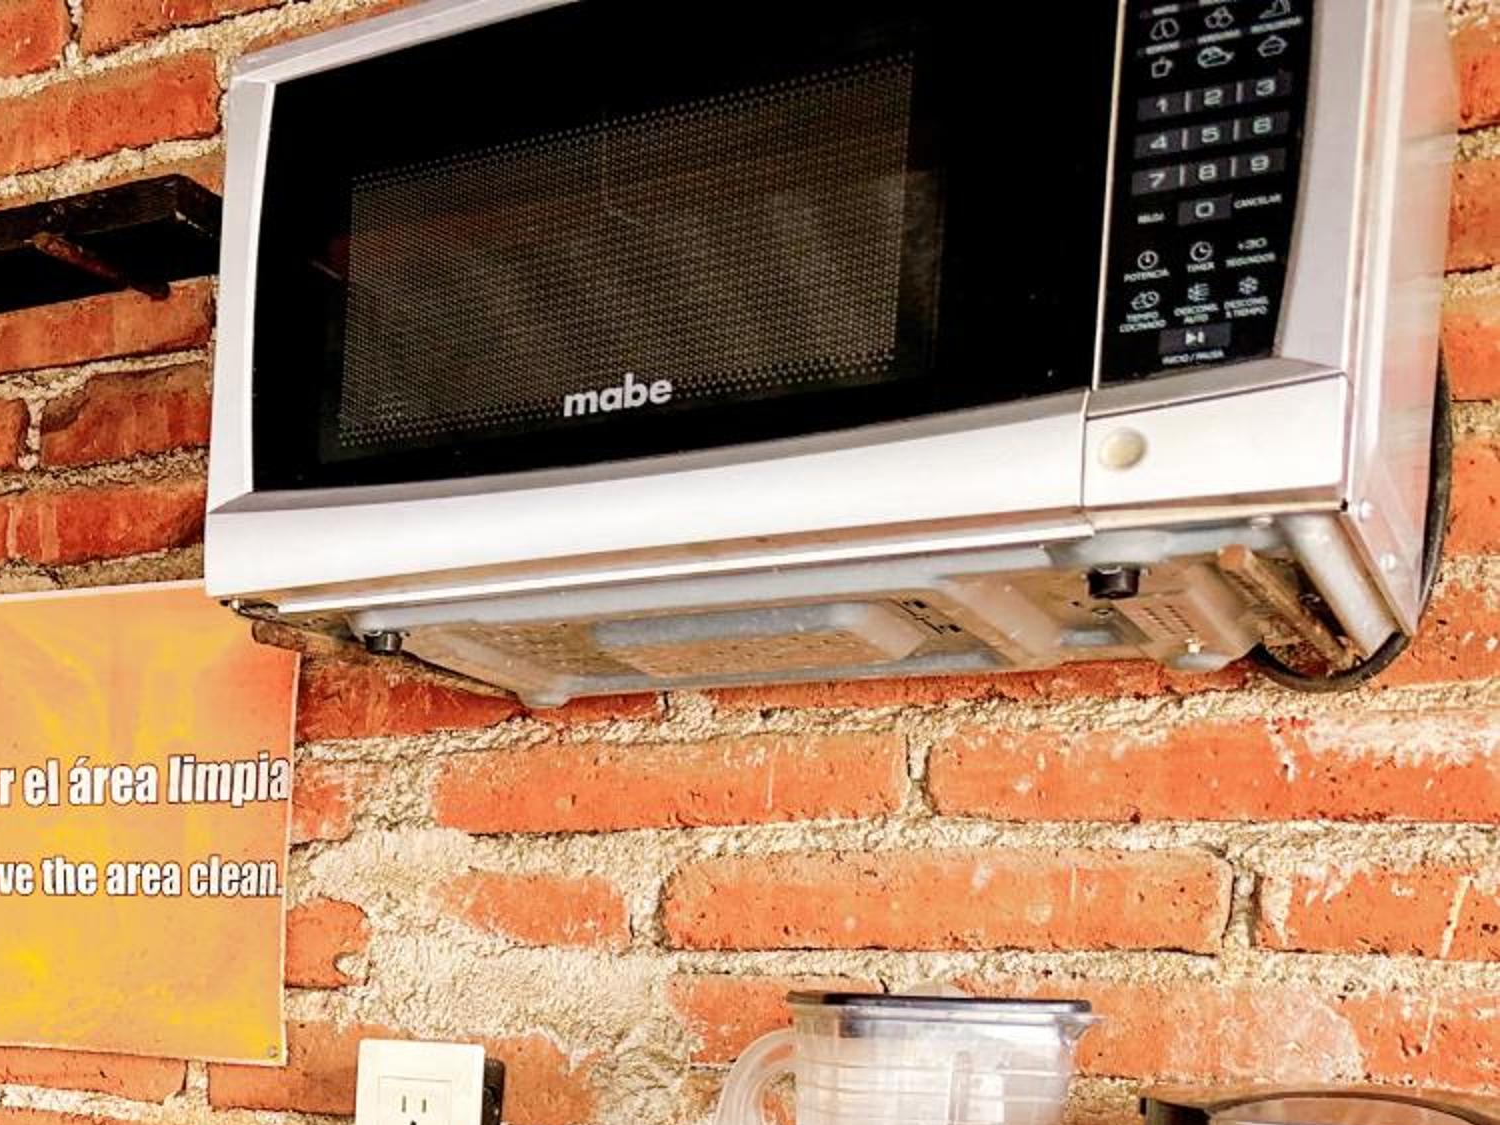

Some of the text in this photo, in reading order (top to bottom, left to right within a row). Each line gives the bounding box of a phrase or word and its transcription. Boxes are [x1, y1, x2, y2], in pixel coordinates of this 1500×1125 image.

[1156, 78, 1276, 113] 1 2 3
[1150, 116, 1272, 150] 4 5 6
[1148, 154, 1269, 189] 7 8 9
[1195, 201, 1215, 219] 0
[1123, 268, 1171, 283] POTENCIA
[563, 372, 673, 418] mabe
[23, 758, 60, 807] el
[68, 756, 159, 806] área
[167, 751, 290, 808] limpia
[41, 855, 98, 896] the
[105, 860, 182, 897] area
[188, 854, 285, 898] clean.
